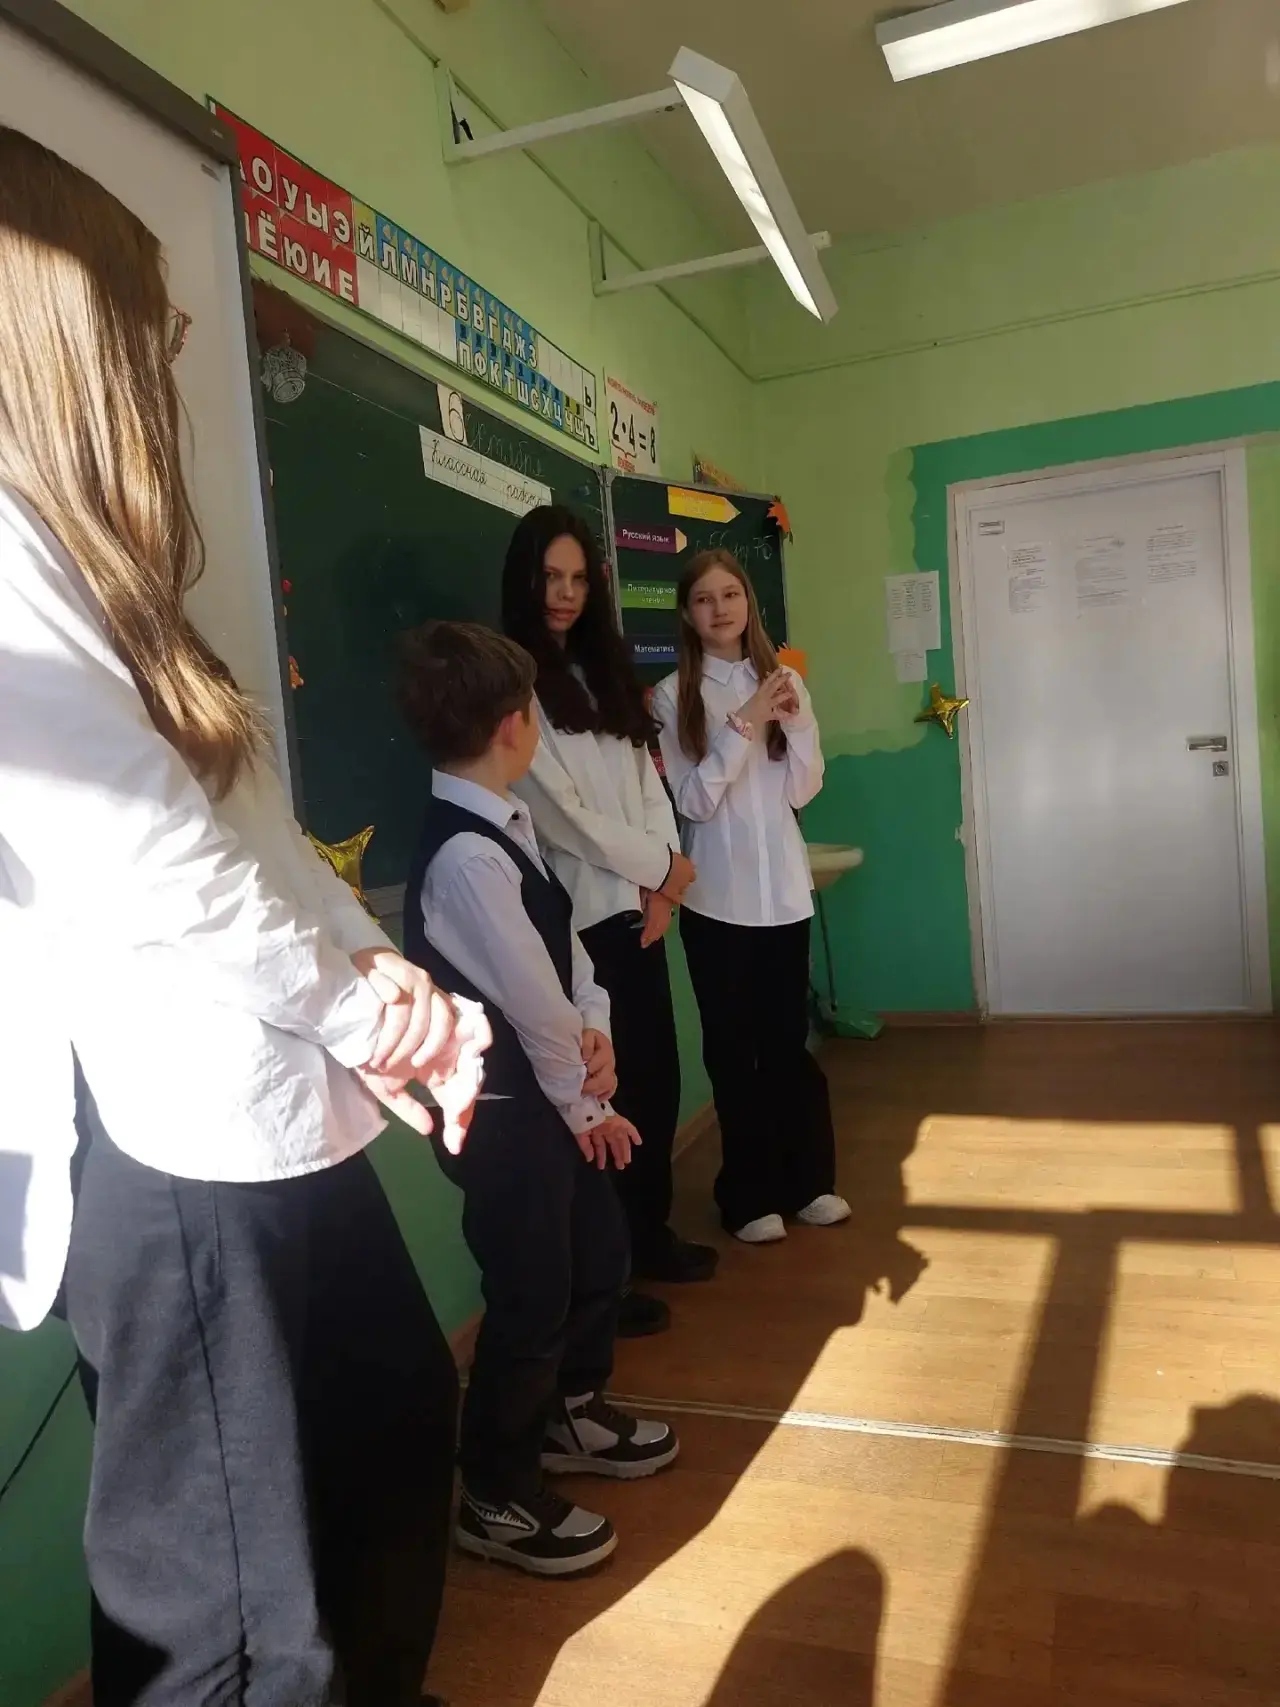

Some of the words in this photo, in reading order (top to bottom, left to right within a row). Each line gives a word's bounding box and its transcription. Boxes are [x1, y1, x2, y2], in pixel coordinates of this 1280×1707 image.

[448, 391, 464, 443] 6
[622, 529, 651, 542] Русский
[652, 535, 671, 543] язык
[634, 644, 675, 653] Математика
